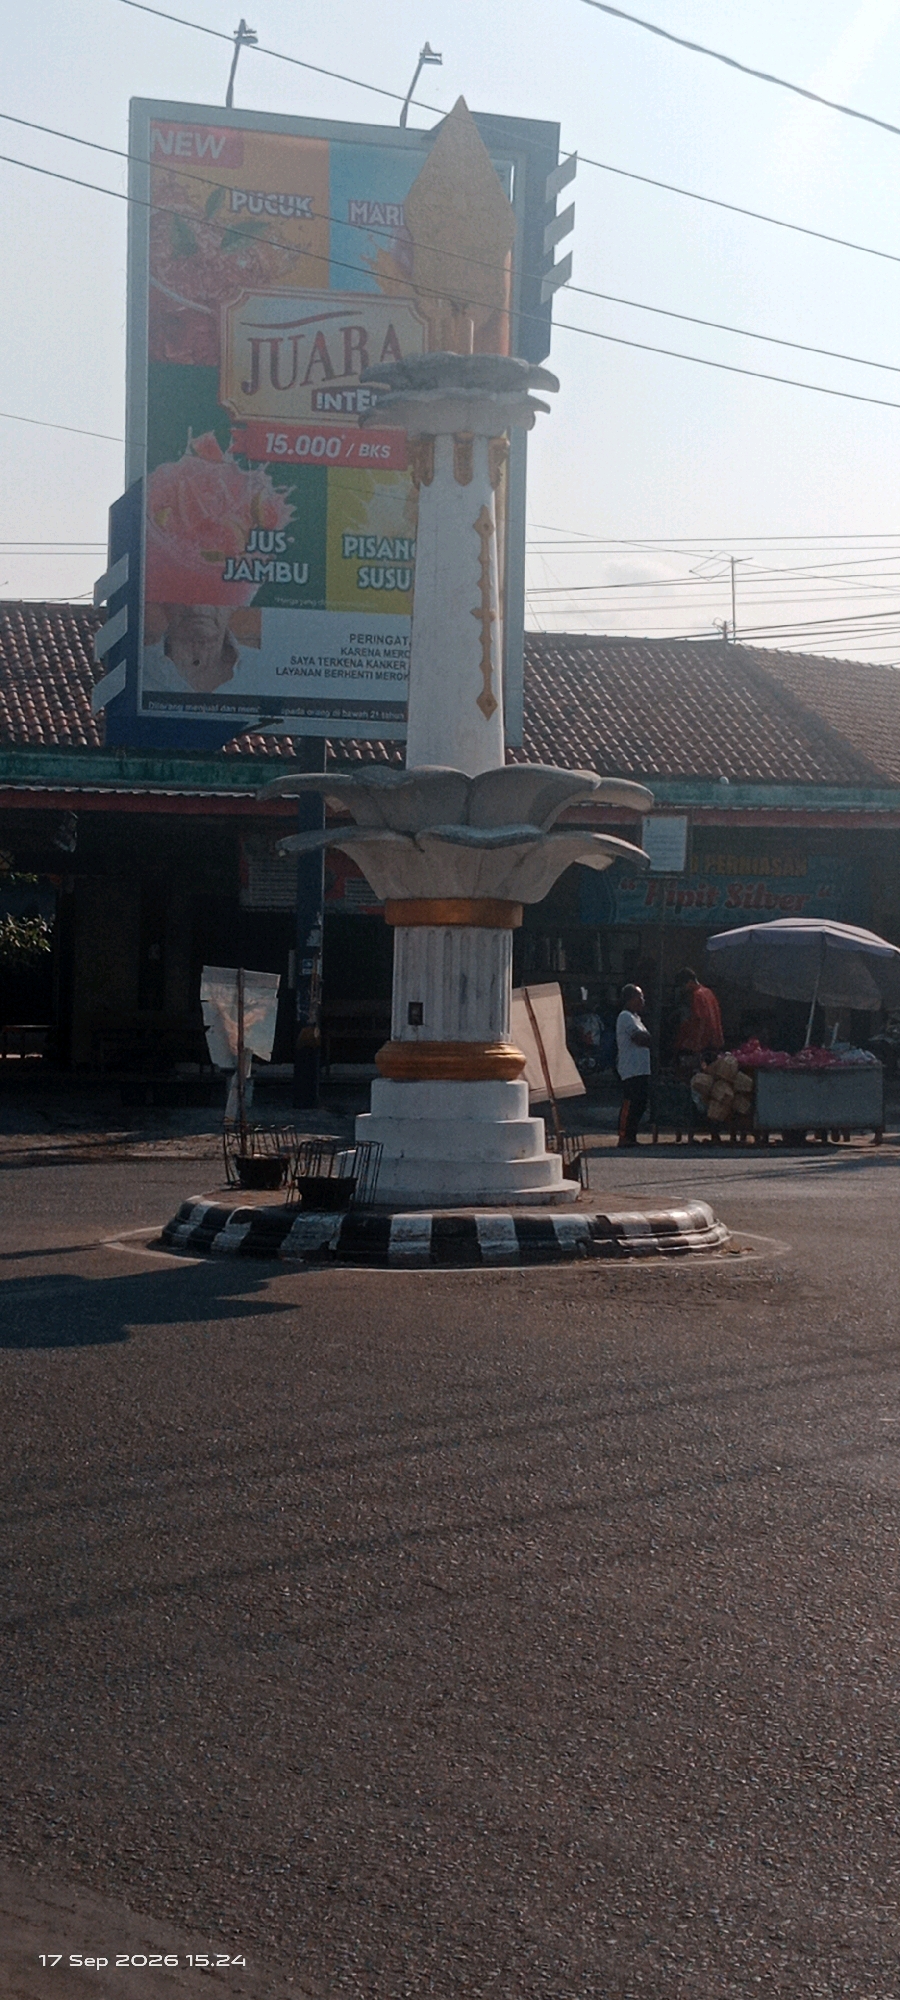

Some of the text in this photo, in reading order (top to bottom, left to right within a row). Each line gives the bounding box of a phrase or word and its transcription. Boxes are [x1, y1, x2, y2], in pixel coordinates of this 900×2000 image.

[151, 128, 226, 160] NEW
[231, 190, 312, 218] PUCUK
[240, 323, 403, 396] JUARA
[358, 444, 391, 458] BKS
[246, 530, 287, 553] JUS
[223, 559, 308, 584] JAMBU
[358, 567, 411, 590] SUSU
[349, 633, 411, 646] PERINGAT
[341, 647, 381, 657] KARENA
[290, 656, 407, 671] SAYA TERKENA KANKER
[276, 667, 321, 677] LAYANAN
[324, 669, 373, 680] BERHENTI
[220, 704, 237, 712] dan
